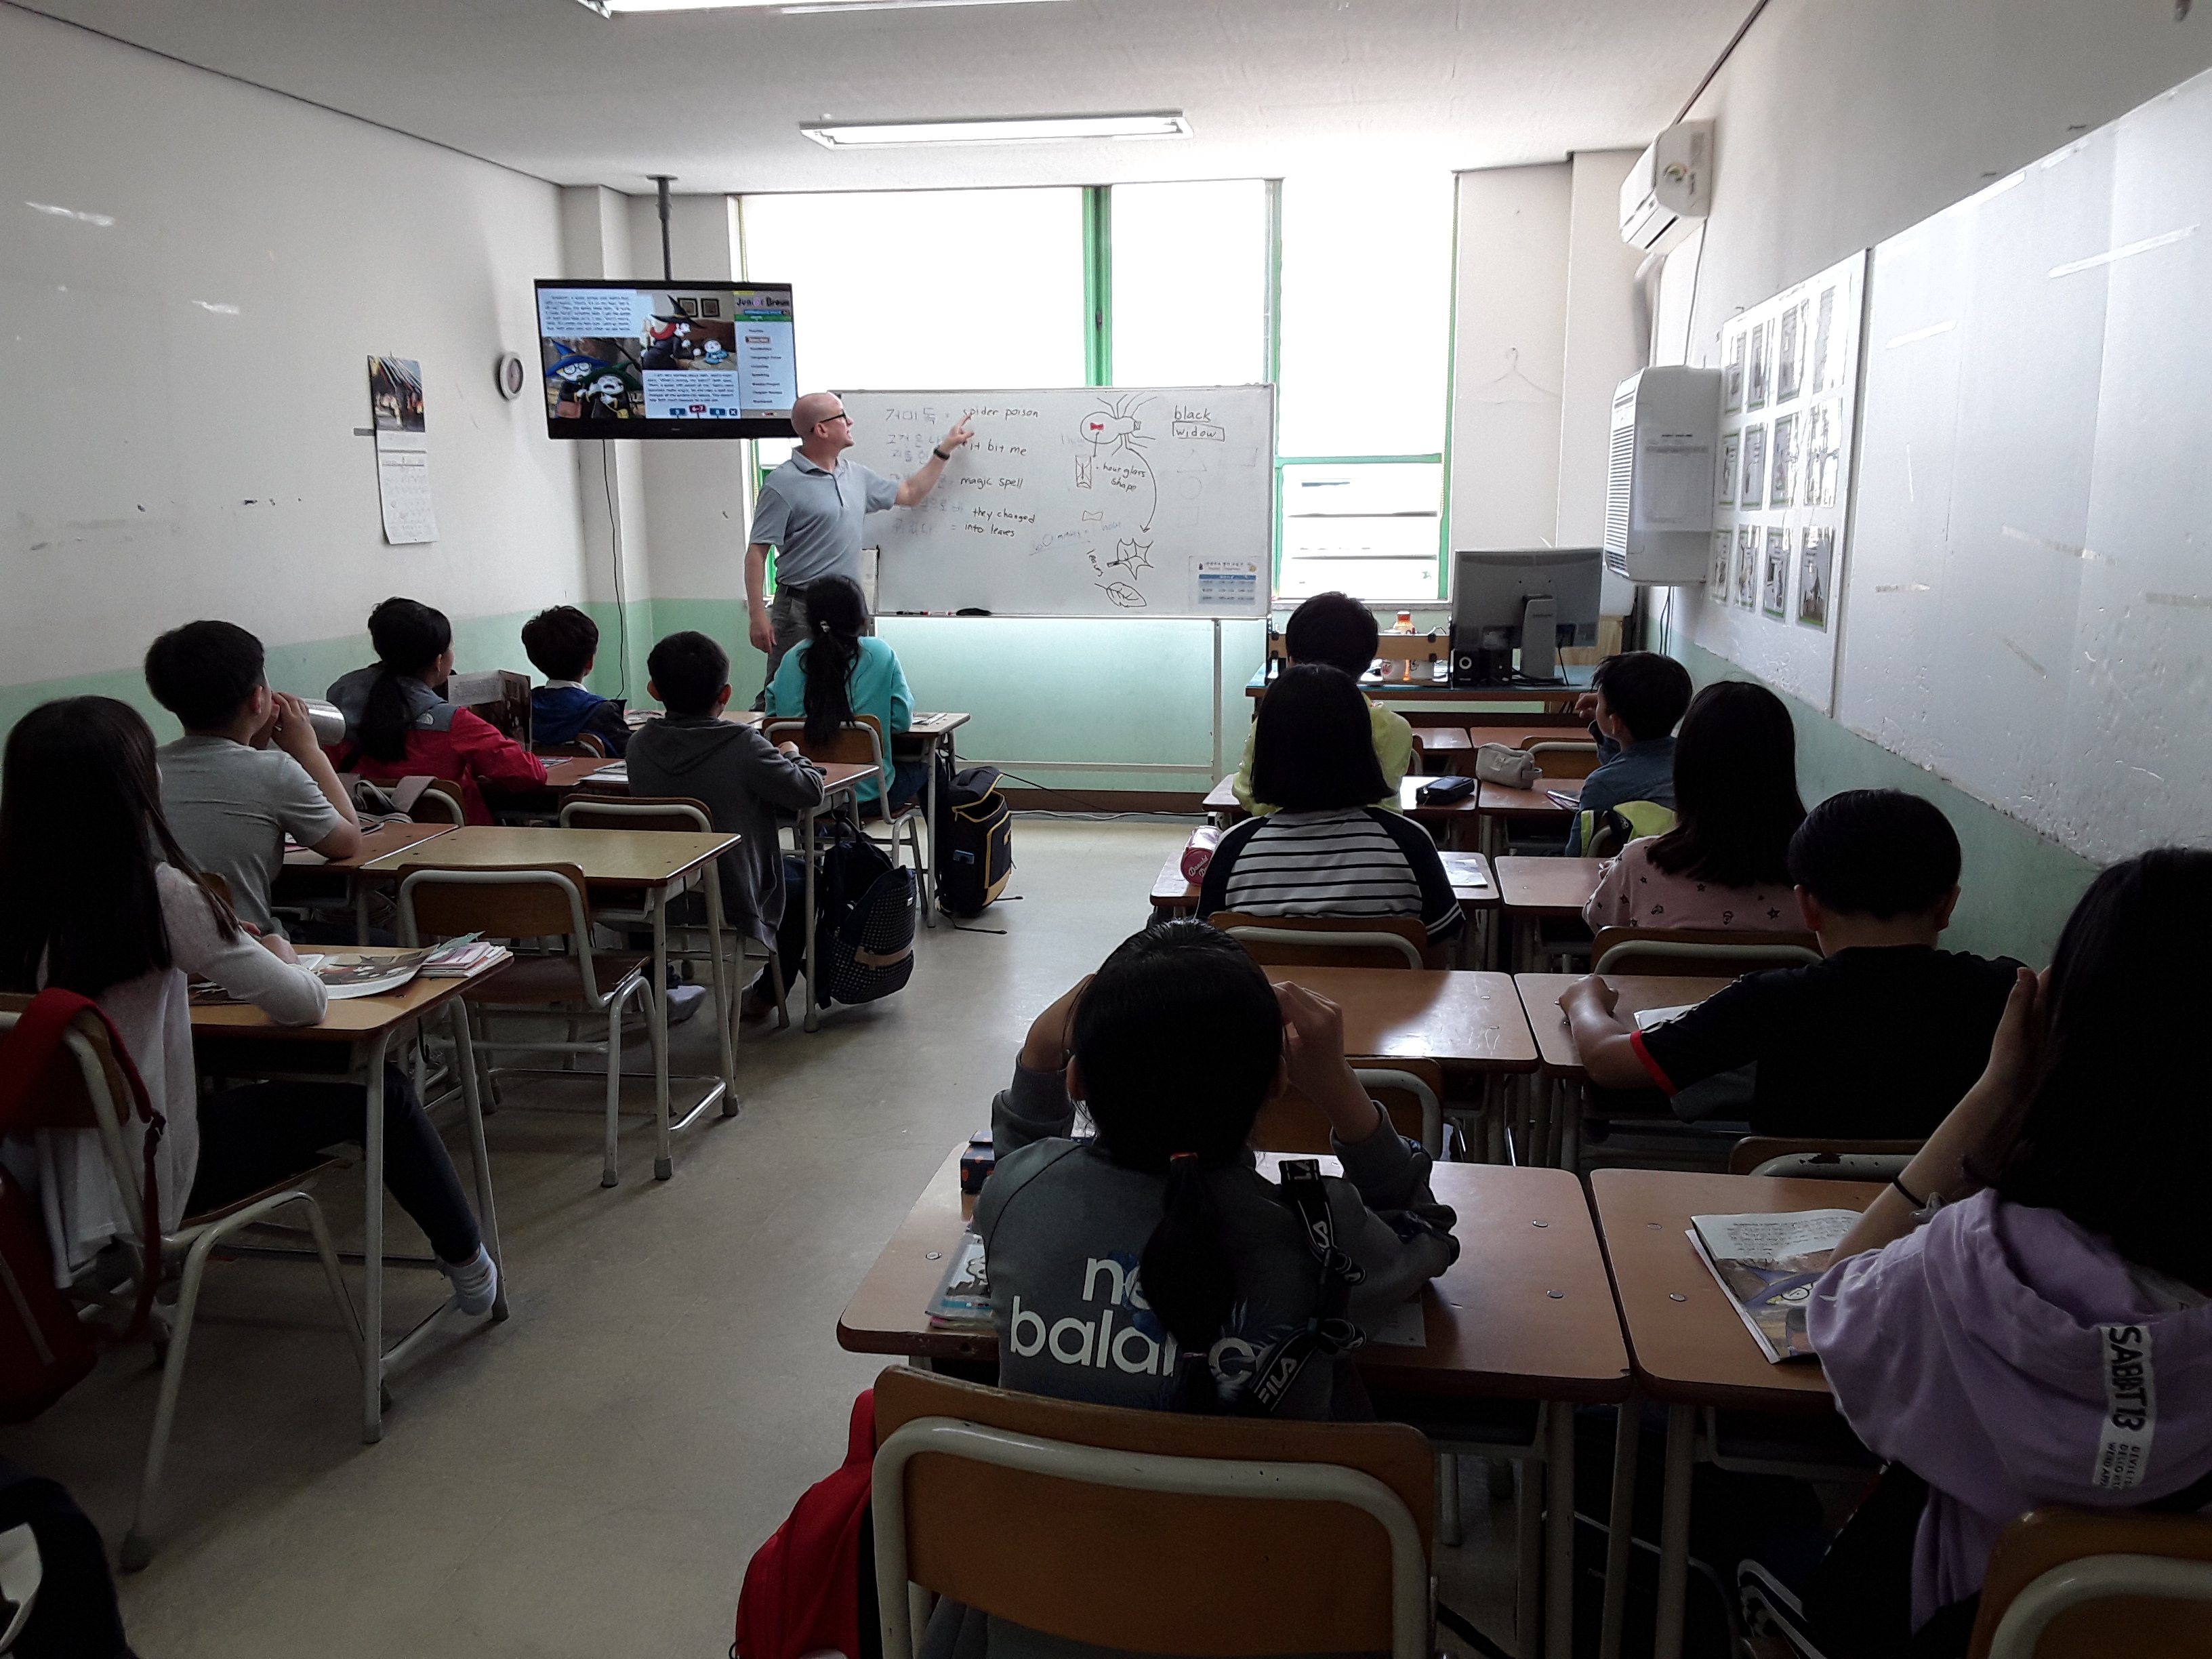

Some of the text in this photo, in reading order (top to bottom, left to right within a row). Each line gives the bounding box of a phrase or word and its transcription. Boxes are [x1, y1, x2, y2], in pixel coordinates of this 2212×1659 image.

[1005, 408, 1038, 421] poison
[1174, 405, 1211, 421] black
[1176, 426, 1216, 438] widow
[970, 438, 1027, 456] it bit me
[960, 477, 992, 490] magic
[998, 477, 1023, 490] spell
[1110, 478, 1137, 493] shape
[972, 506, 993, 522] they
[964, 523, 1015, 537] into leaves
[1081, 1256, 1151, 1311] ne
[1257, 1357, 1298, 1405] FILA
